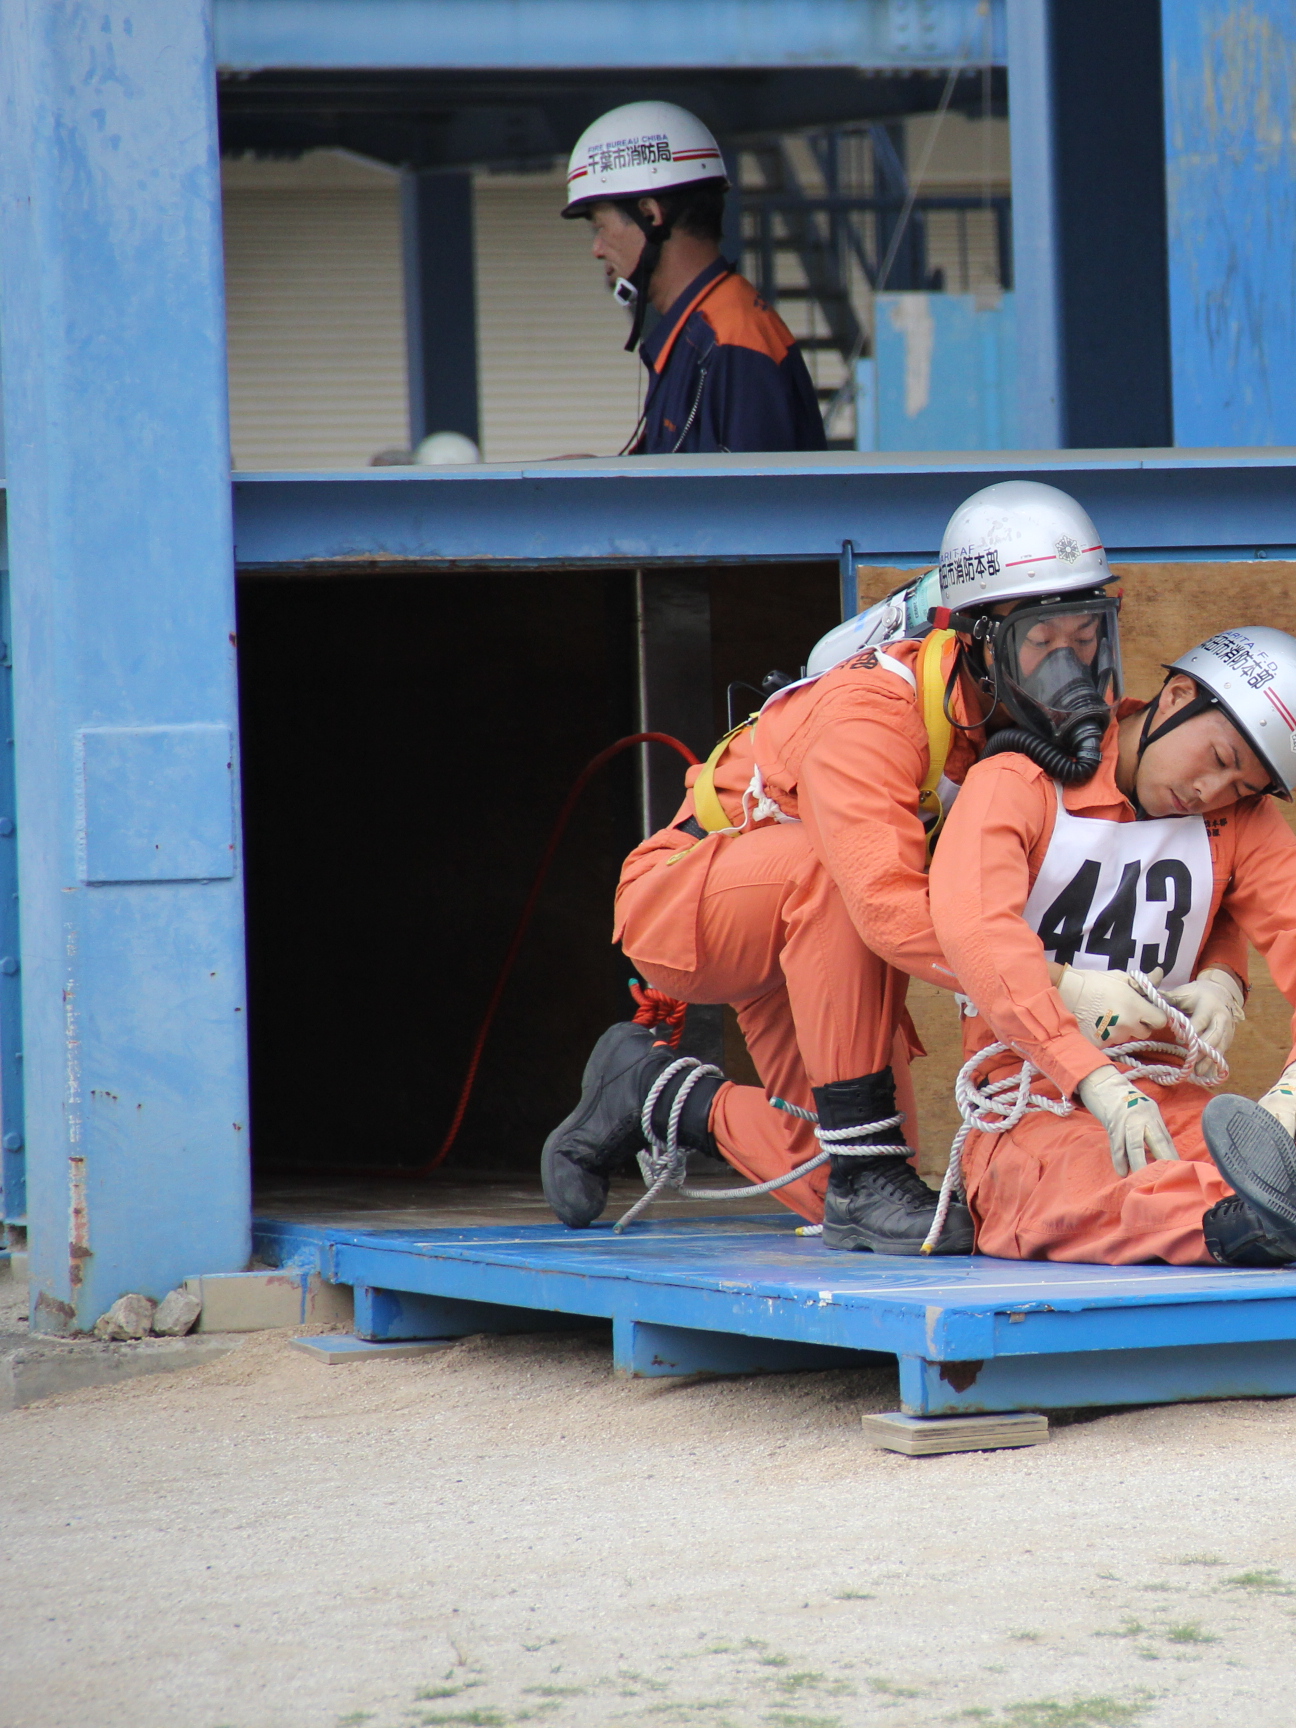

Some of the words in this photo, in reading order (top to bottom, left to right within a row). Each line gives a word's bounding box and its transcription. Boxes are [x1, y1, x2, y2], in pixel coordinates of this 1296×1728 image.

[588, 145, 605, 153] FIRE
[606, 138, 639, 148] BUREAU
[642, 134, 668, 143] CHIBA
[588, 141, 672, 174] 千葉市消防局
[939, 549, 1001, 591] 田市消防本部
[1037, 859, 1192, 979] 443
